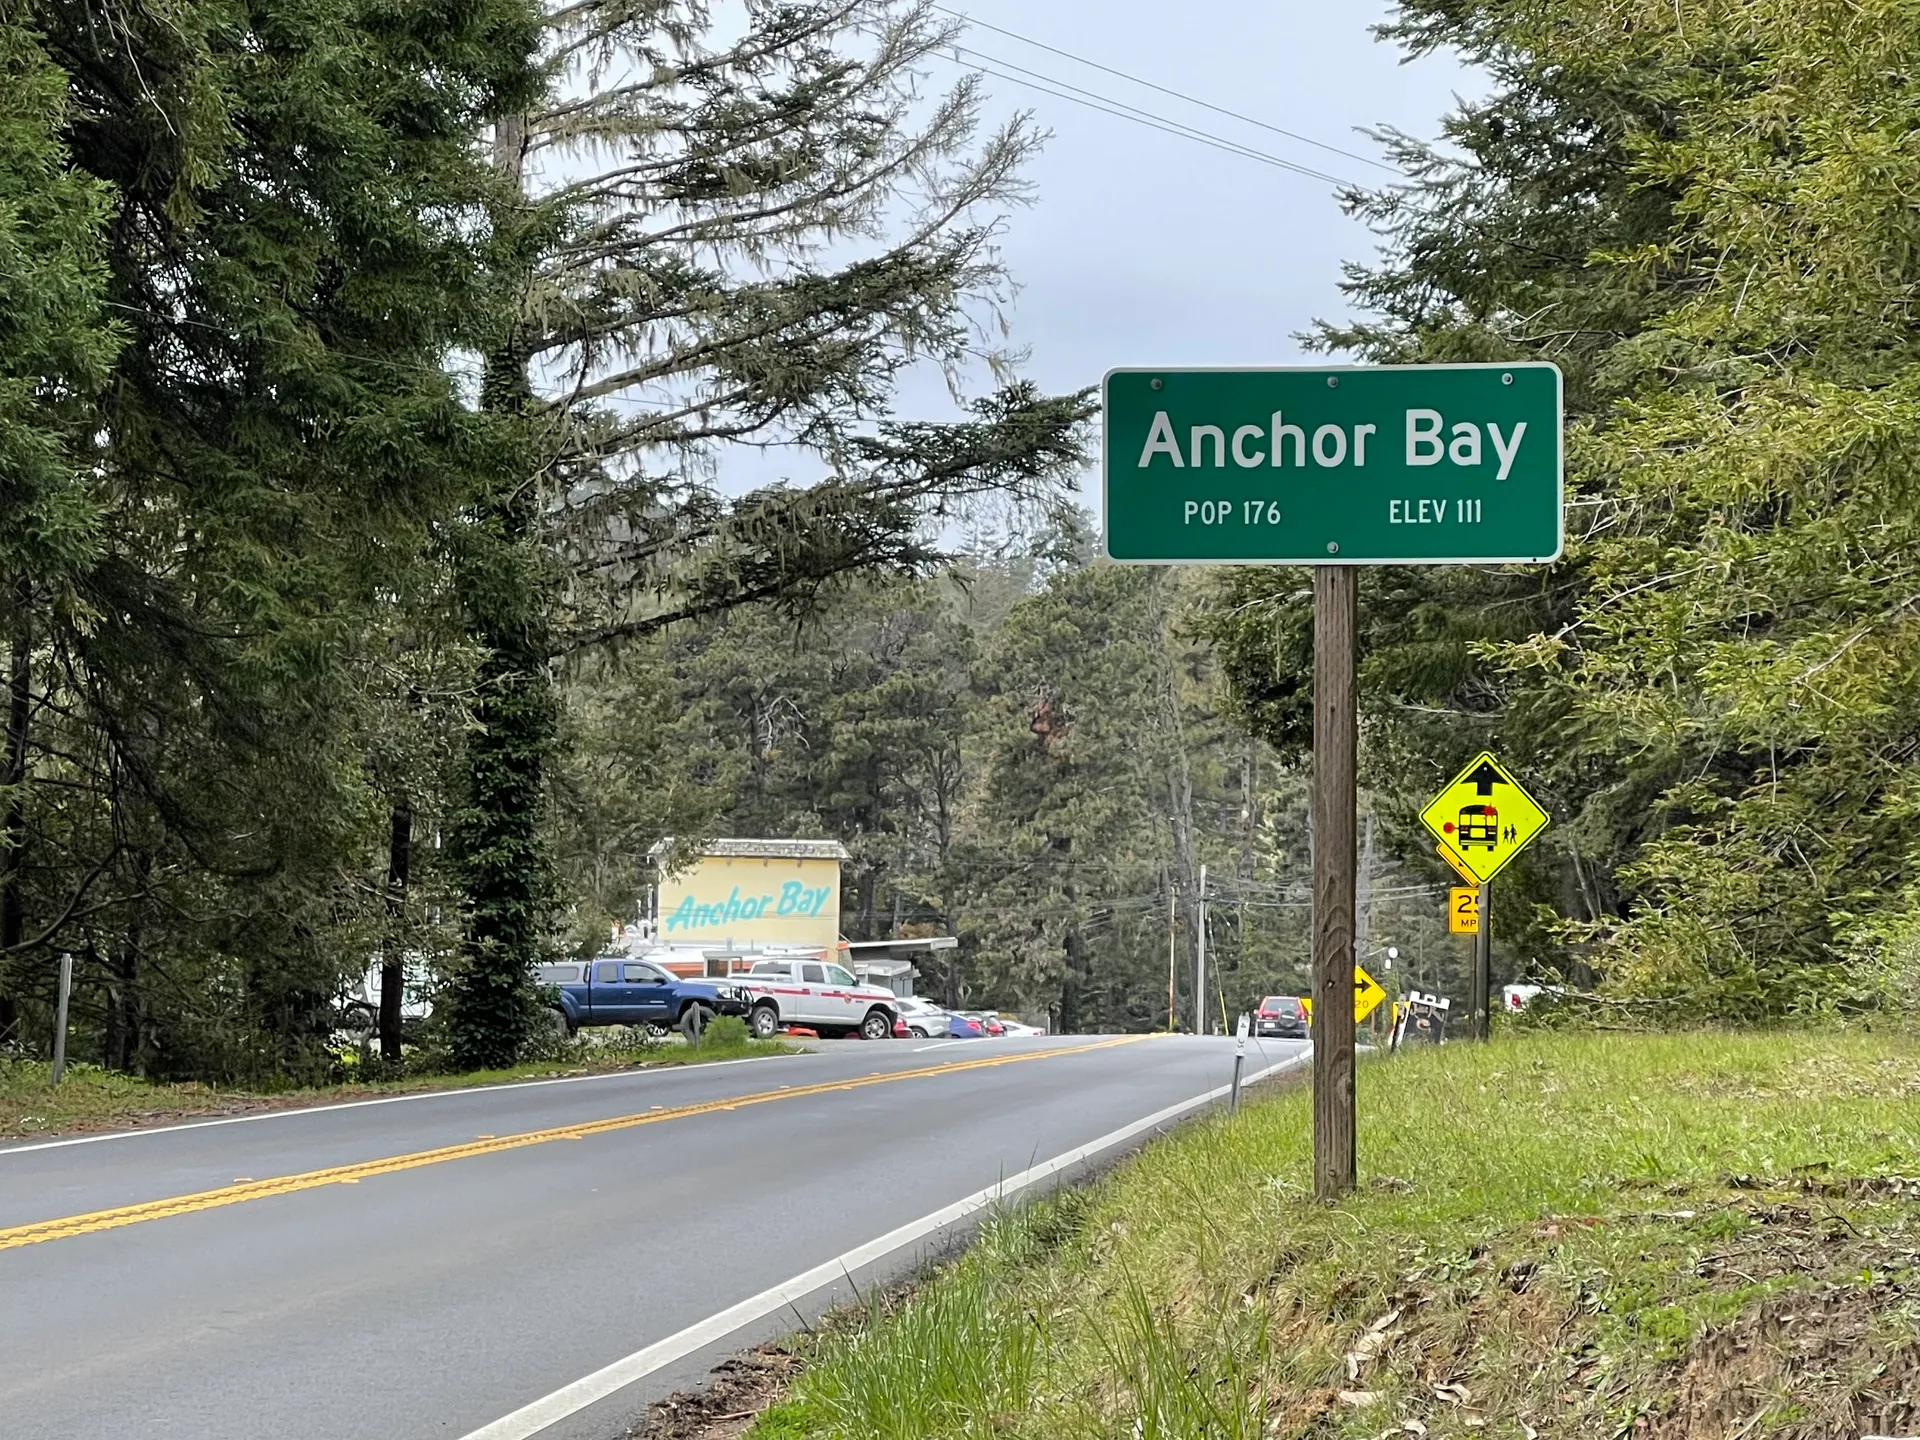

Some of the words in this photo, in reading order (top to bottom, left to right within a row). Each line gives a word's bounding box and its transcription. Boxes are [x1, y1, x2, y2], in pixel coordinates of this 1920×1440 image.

[1138, 410, 1376, 468] Anchor
[1406, 408, 1528, 480] Bay
[1184, 500, 1232, 525] POP
[1243, 500, 1281, 525] 176
[1389, 499, 1447, 523] ELEV
[1457, 499, 1481, 523] 111
[666, 885, 773, 933] Anchor
[776, 880, 831, 918] Bay
[1461, 919, 1477, 927] MP
